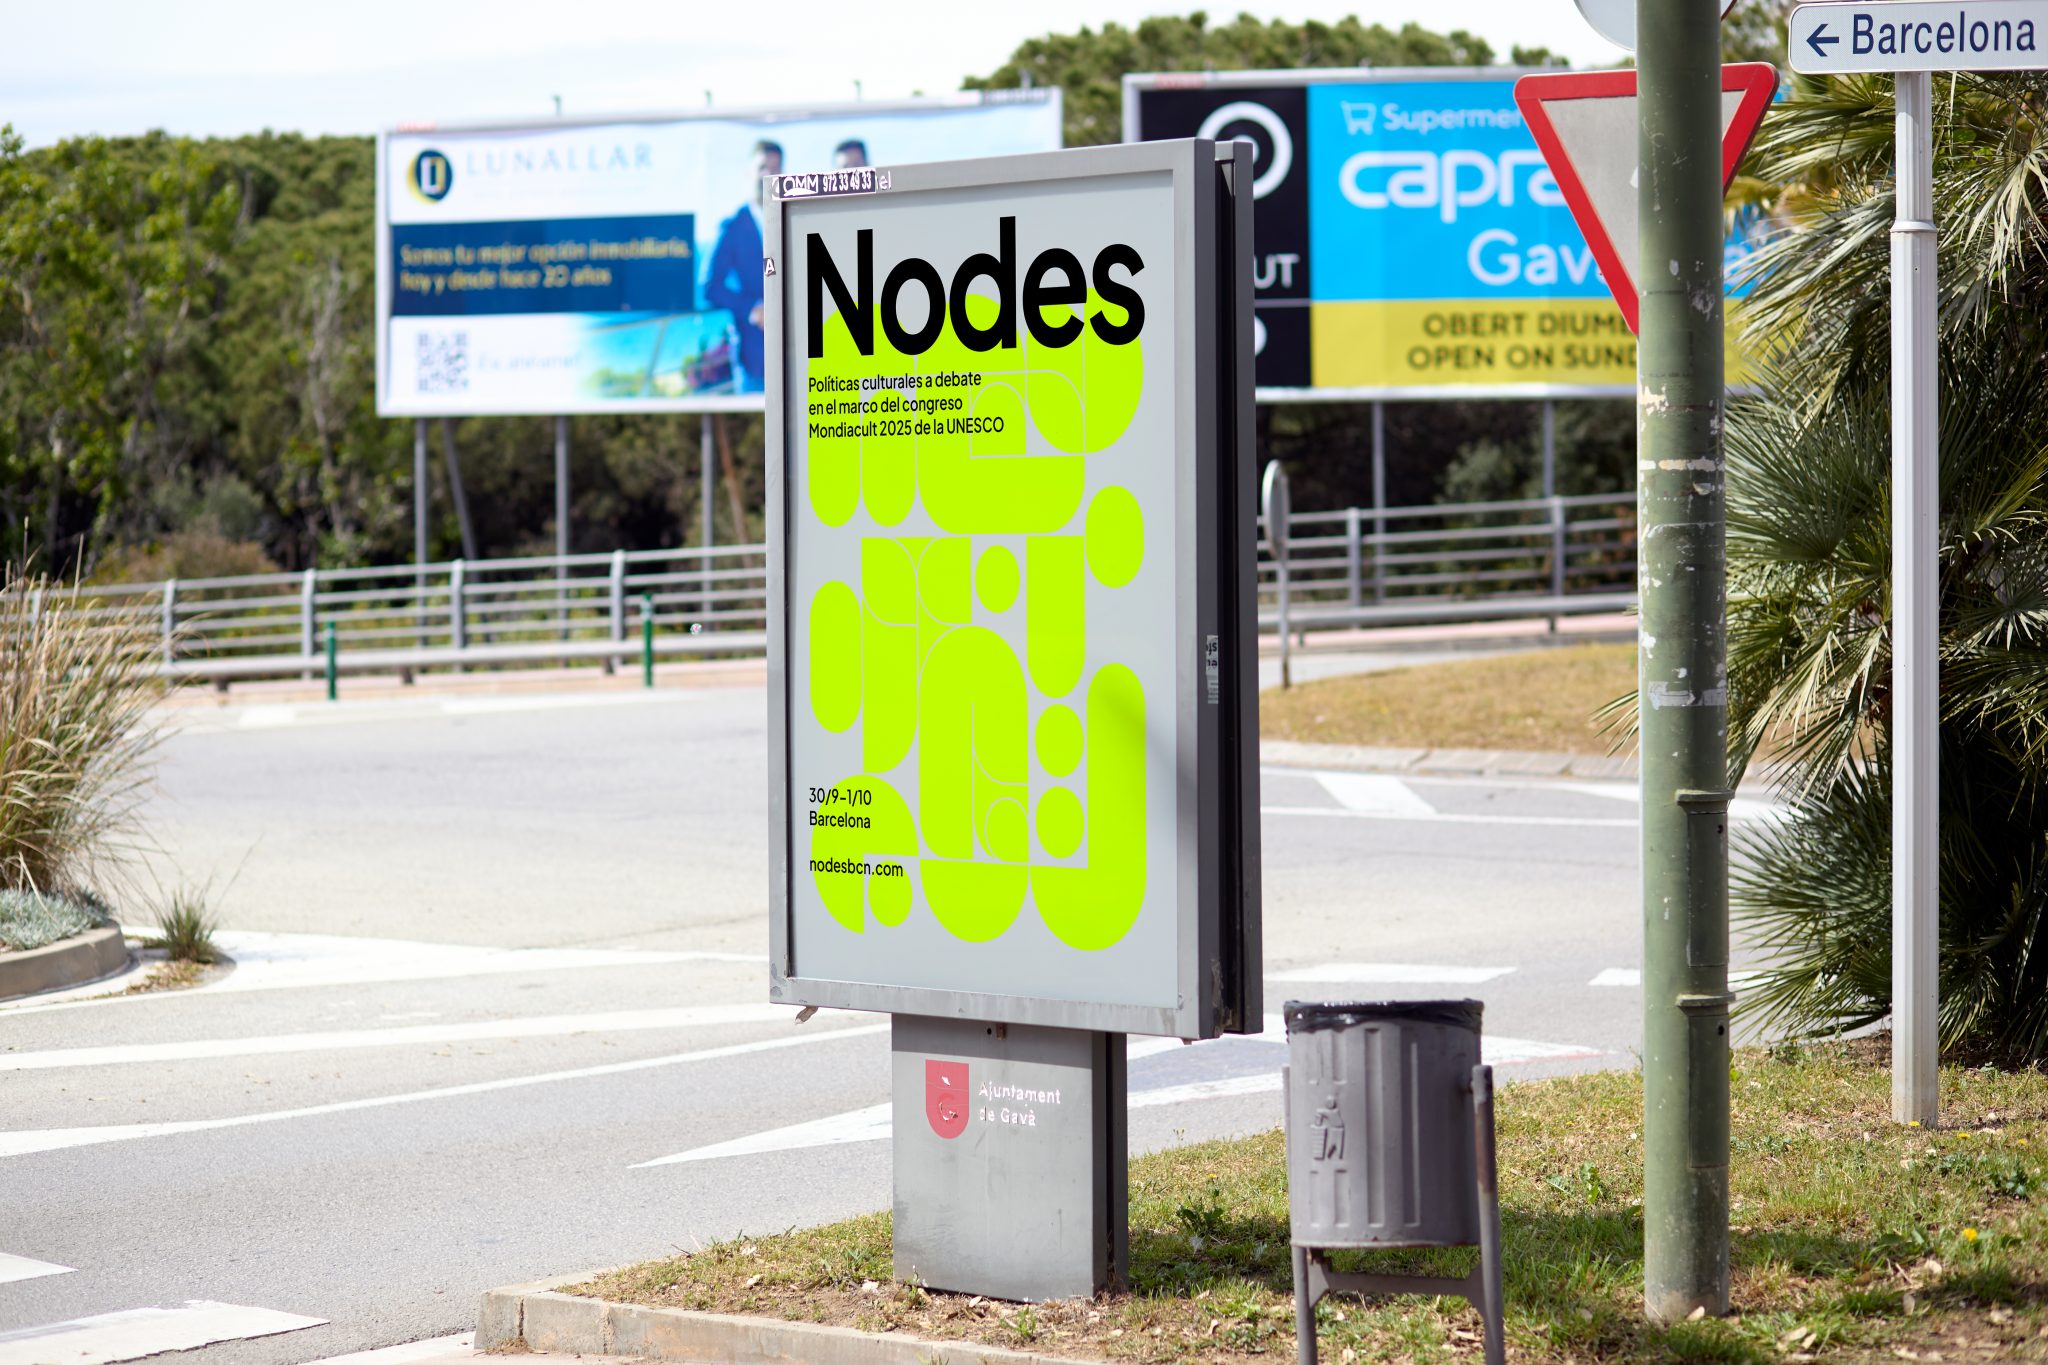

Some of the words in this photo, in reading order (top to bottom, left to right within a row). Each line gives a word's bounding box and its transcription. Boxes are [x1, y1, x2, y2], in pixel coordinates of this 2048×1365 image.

[1852, 10, 2036, 55] Barcelona
[1382, 102, 1526, 135] Supermer
[823, 175, 838, 192] 972
[839, 173, 849, 191] 33
[1468, 229, 1608, 286] Gav
[807, 216, 1145, 358] Nodes
[1423, 313, 1530, 338] OBERT
[1407, 346, 1494, 371] OPEN
[1506, 345, 1554, 369] ON
[808, 375, 860, 393] Políticas
[862, 373, 923, 390] culturales
[925, 375, 933, 388] a
[935, 371, 982, 388] debate
[808, 402, 824, 416] en
[826, 399, 836, 415] el
[839, 400, 878, 414] marco
[880, 397, 900, 413] del
[902, 397, 963, 415] congreso
[809, 422, 878, 439] Mondiacult
[880, 420, 912, 437] 2025
[914, 419, 931, 435] de
[933, 419, 944, 435] la
[946, 416, 1005, 434] UNESCO
[809, 810, 871, 829] Barcelona
[809, 857, 903, 877] nodesbcn.com
[978, 1081, 1061, 1105] Ajuntament
[1000, 1108, 1036, 1127] Gavà
